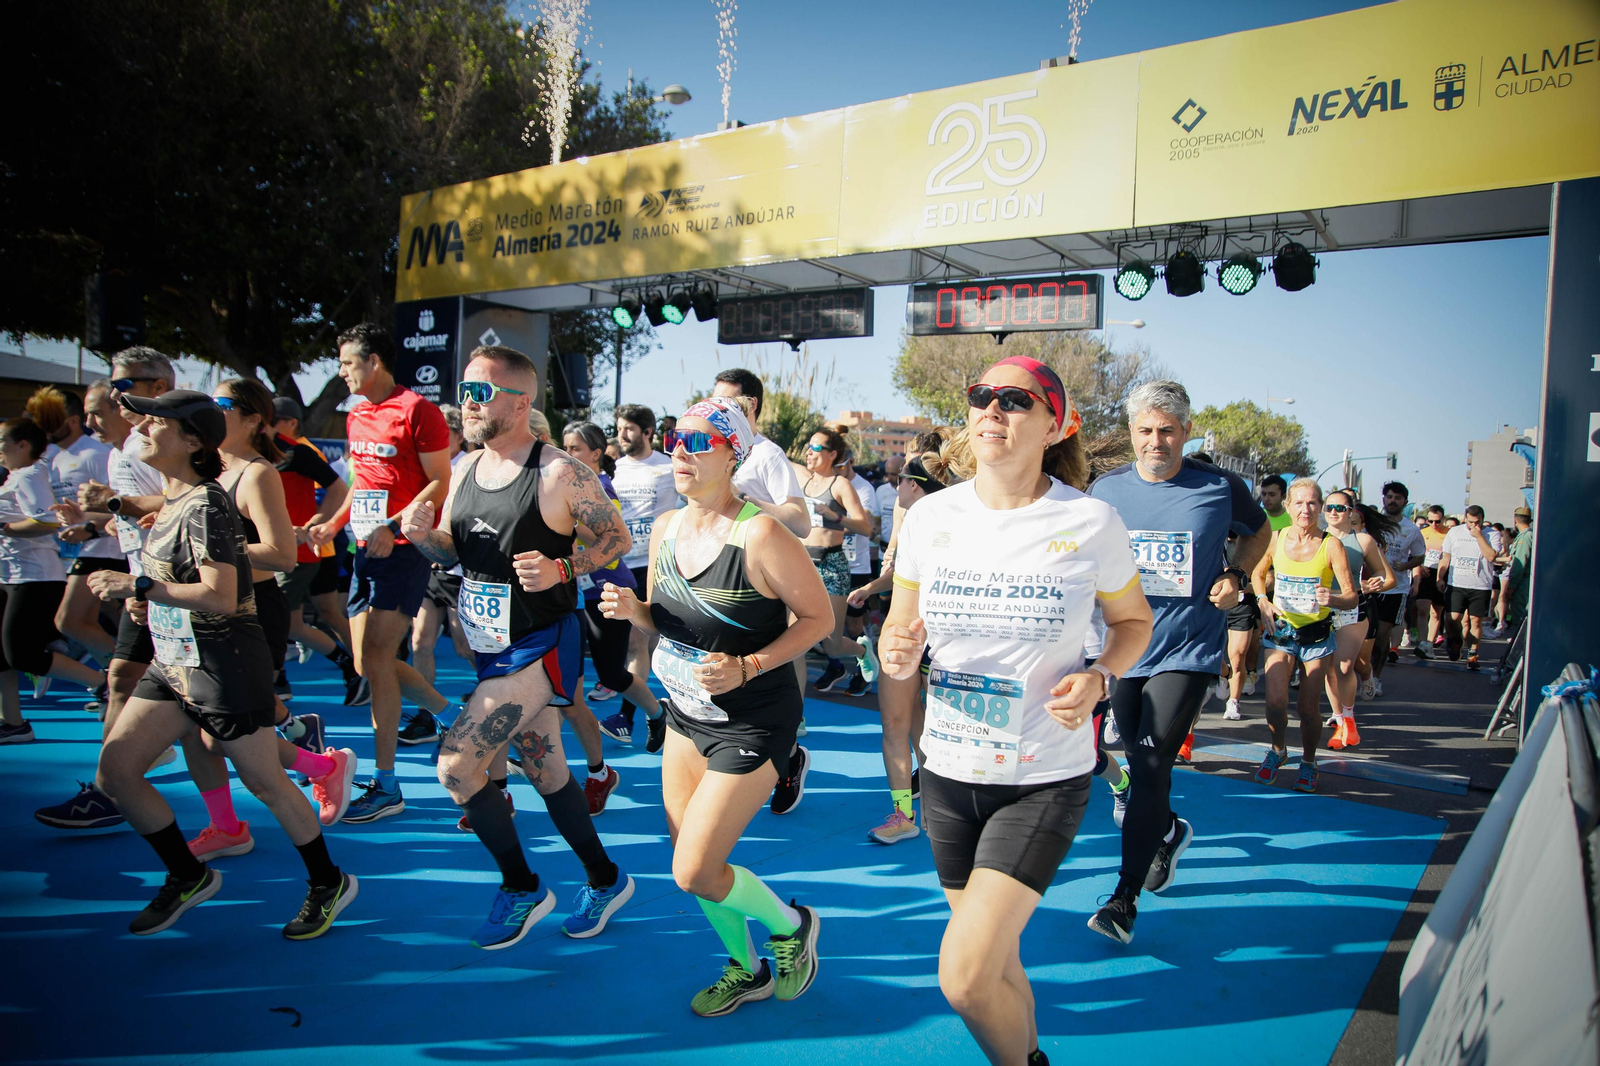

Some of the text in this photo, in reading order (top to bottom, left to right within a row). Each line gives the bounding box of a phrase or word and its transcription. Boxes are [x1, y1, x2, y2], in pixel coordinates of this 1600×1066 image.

[1496, 38, 1600, 79] ALME
[1495, 72, 1573, 98] CIUDAD
[1287, 77, 1408, 136] NEXAL
[1170, 127, 1264, 150] COOPERACIÓN
[1296, 125, 1319, 136] 2020
[925, 88, 1047, 197] 25
[1169, 148, 1200, 161] 2005
[495, 195, 623, 231] Medio Maratón
[922, 189, 1044, 228] EDICIÓN
[632, 205, 795, 240] RAMÓN RUIZ ANDÚJAR
[492, 218, 621, 258] Almería 2024
[403, 332, 449, 352] cajamar
[1132, 543, 1185, 563] 5188
[935, 566, 1063, 585] Medio Maratón
[929, 580, 1064, 601] Almería 2024
[1279, 582, 1316, 595] 5782
[925, 600, 1065, 615] RAMÓN RUIZ ANDÚJAR
[476, 616, 494, 624] JORGE
[967, 680, 984, 689] 2024
[931, 687, 1010, 728] 5398
[937, 719, 990, 736] CONCEPCION
